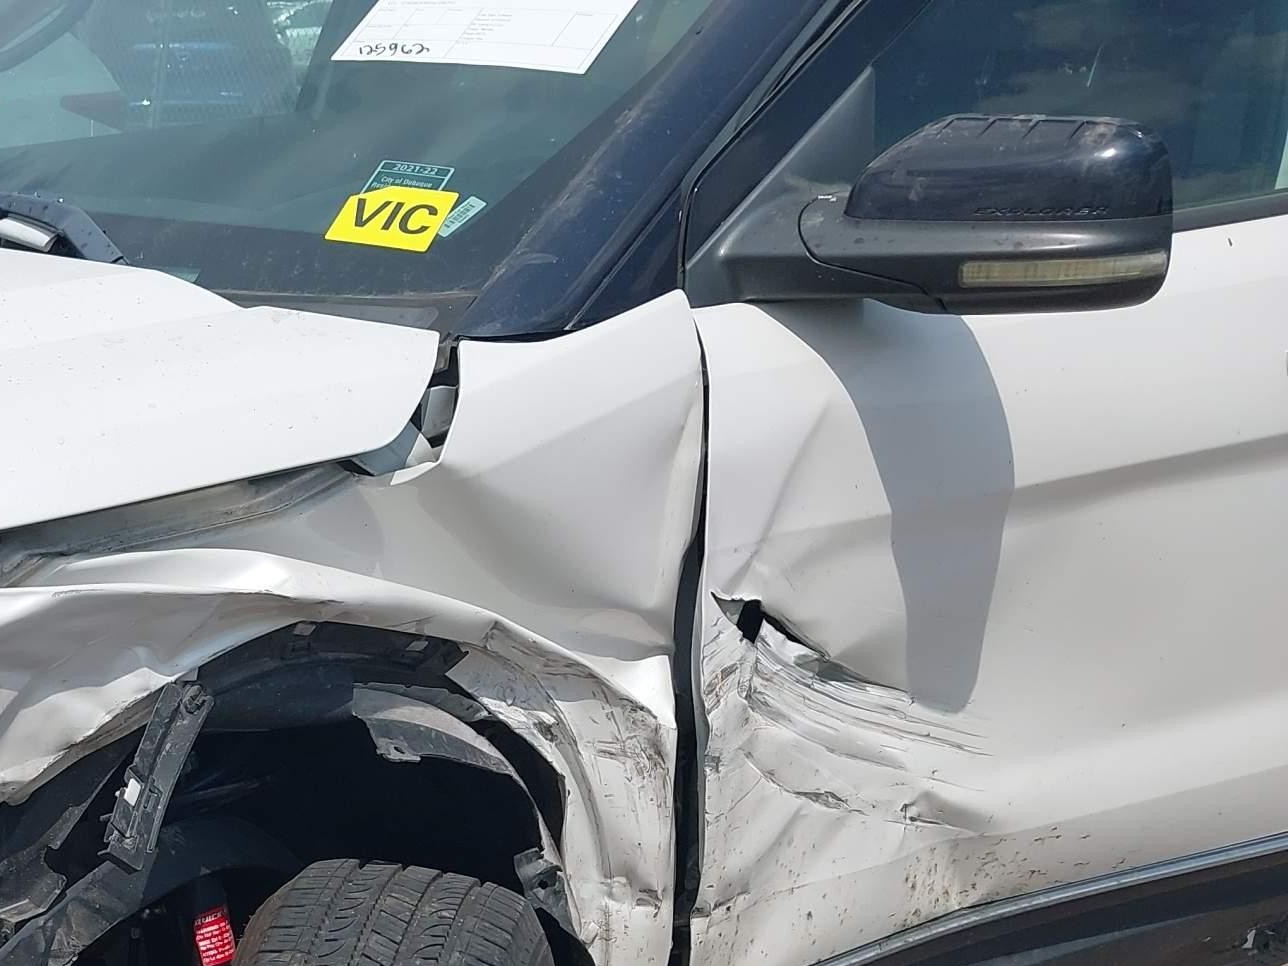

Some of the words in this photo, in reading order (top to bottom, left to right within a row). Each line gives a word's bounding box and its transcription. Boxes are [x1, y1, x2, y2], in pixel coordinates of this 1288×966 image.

[393, 164, 437, 175] 2021-22
[381, 176, 394, 185] City
[354, 198, 439, 235] VIC
[973, 206, 1111, 217] EXPLORER
